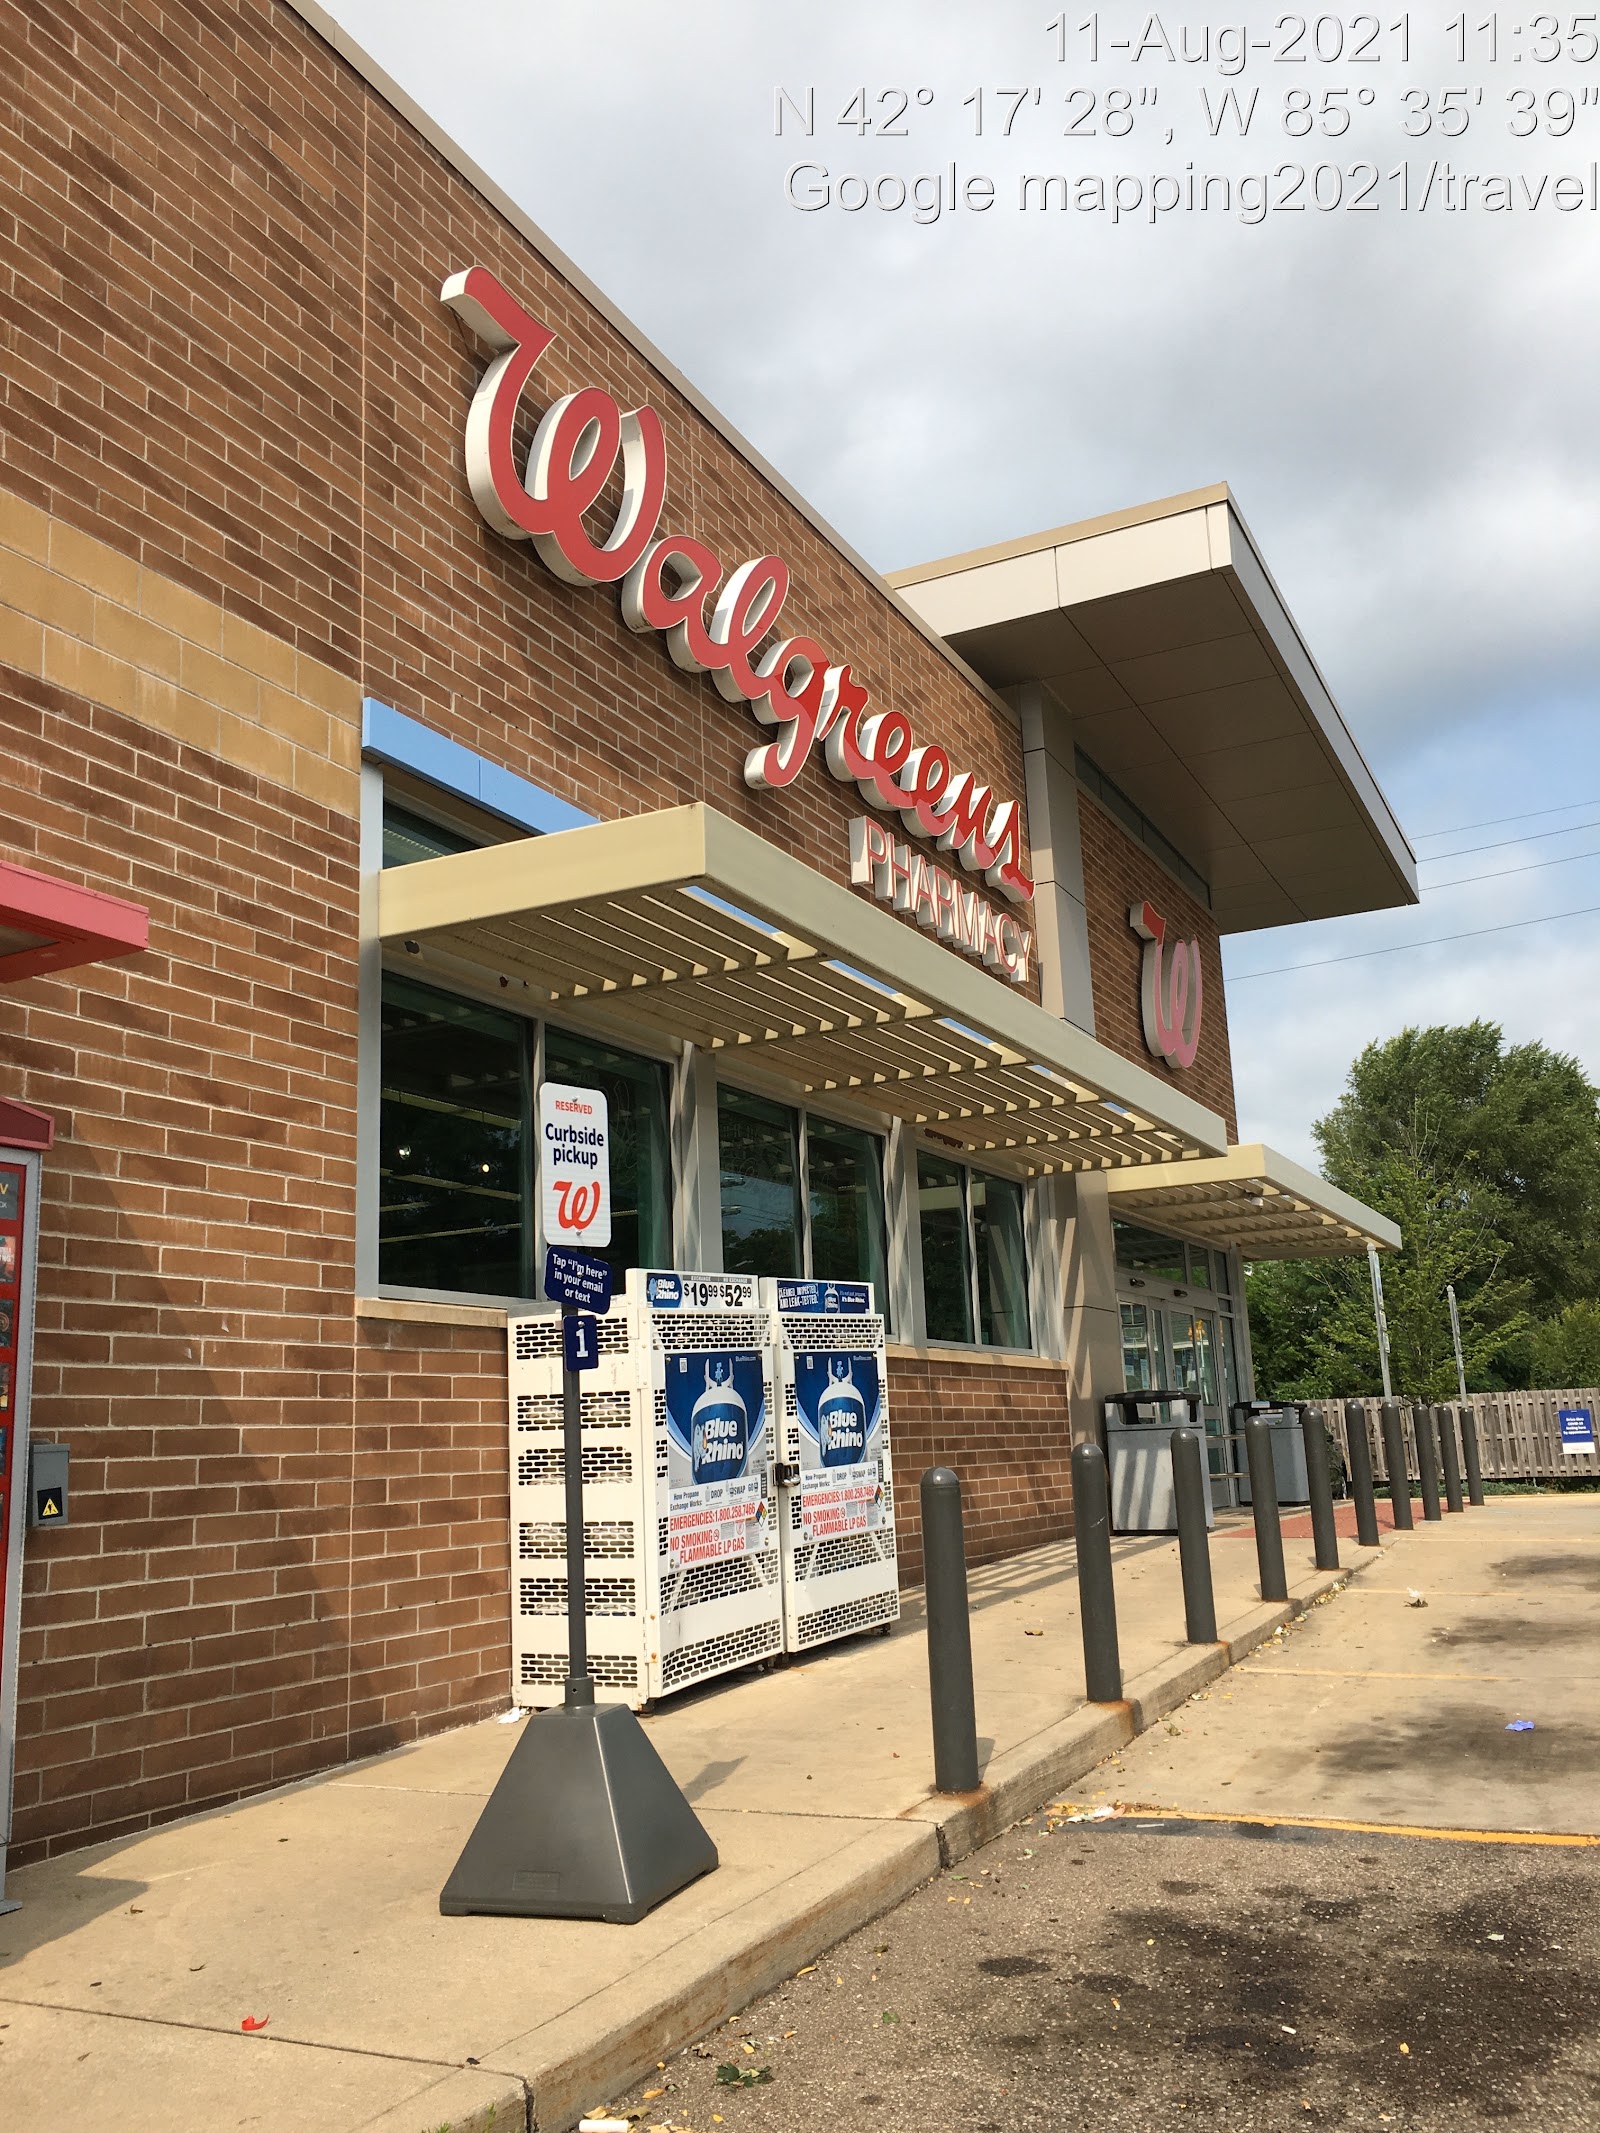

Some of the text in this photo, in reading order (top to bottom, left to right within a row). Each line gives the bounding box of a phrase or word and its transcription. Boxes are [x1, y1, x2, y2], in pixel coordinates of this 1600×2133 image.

[441, 265, 1035, 902] Walgreens
[850, 816, 1032, 983] PHARMACY
[555, 1100, 593, 1115] RESERVED
[545, 1123, 604, 1147] Curbside
[553, 1146, 598, 1169] pickup
[553, 1253, 566, 1269] Tap
[554, 1268, 603, 1294] in your email
[657, 1279, 675, 1290] Blue
[565, 1288, 591, 1303] or text
[780, 1298, 789, 1309] AND
[576, 1328, 588, 1358] 1
[705, 1417, 737, 1440] Blue
[830, 1409, 857, 1428] Blue
[828, 1428, 863, 1450] Rhino
[701, 1438, 744, 1465] Rhino
[837, 1472, 847, 1480] DROP
[683, 1491, 699, 1499] Propane
[711, 1489, 723, 1499] DROP
[733, 1485, 745, 1496] SWAP
[670, 1503, 689, 1511] Exchange
[803, 1512, 811, 1525] NO
[813, 1507, 840, 1523] SMOKING
[812, 1515, 866, 1537] FLAMMABLE LP GAS
[670, 1536, 679, 1551] NO
[681, 1530, 713, 1549] SMOKING
[680, 1537, 744, 1564] FLAMMABLE LP GAS
